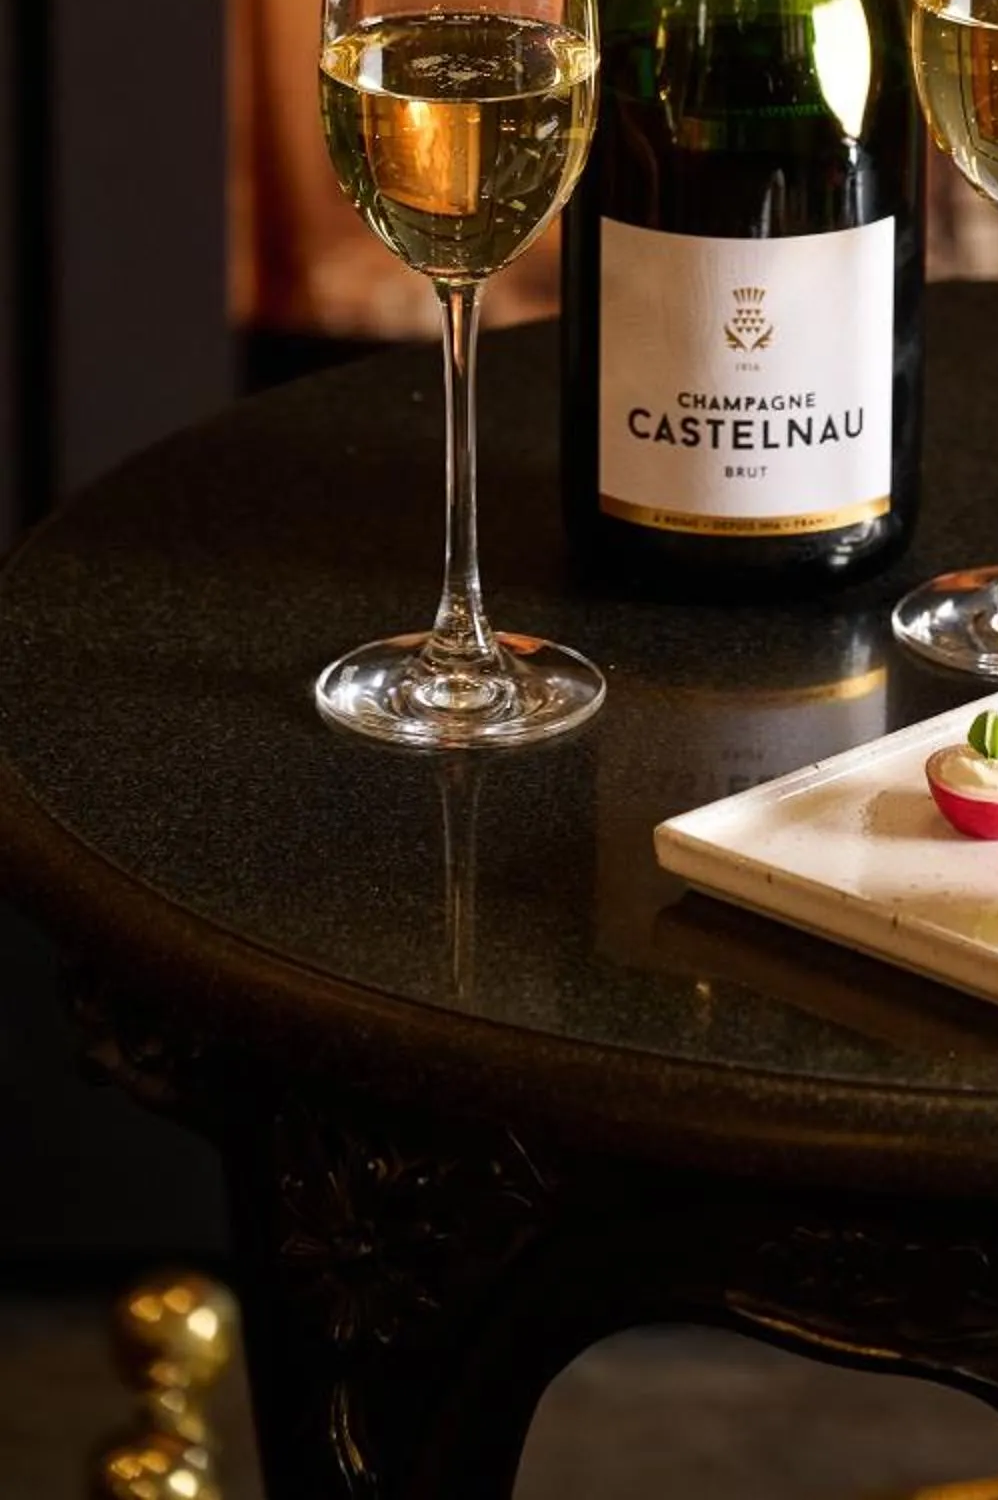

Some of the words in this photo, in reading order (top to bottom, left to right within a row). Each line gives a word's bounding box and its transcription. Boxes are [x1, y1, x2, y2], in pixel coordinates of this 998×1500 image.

[677, 391, 816, 412] CHAMPAGNE
[628, 406, 864, 450] CASTELNAU
[724, 464, 768, 479] BRUT
